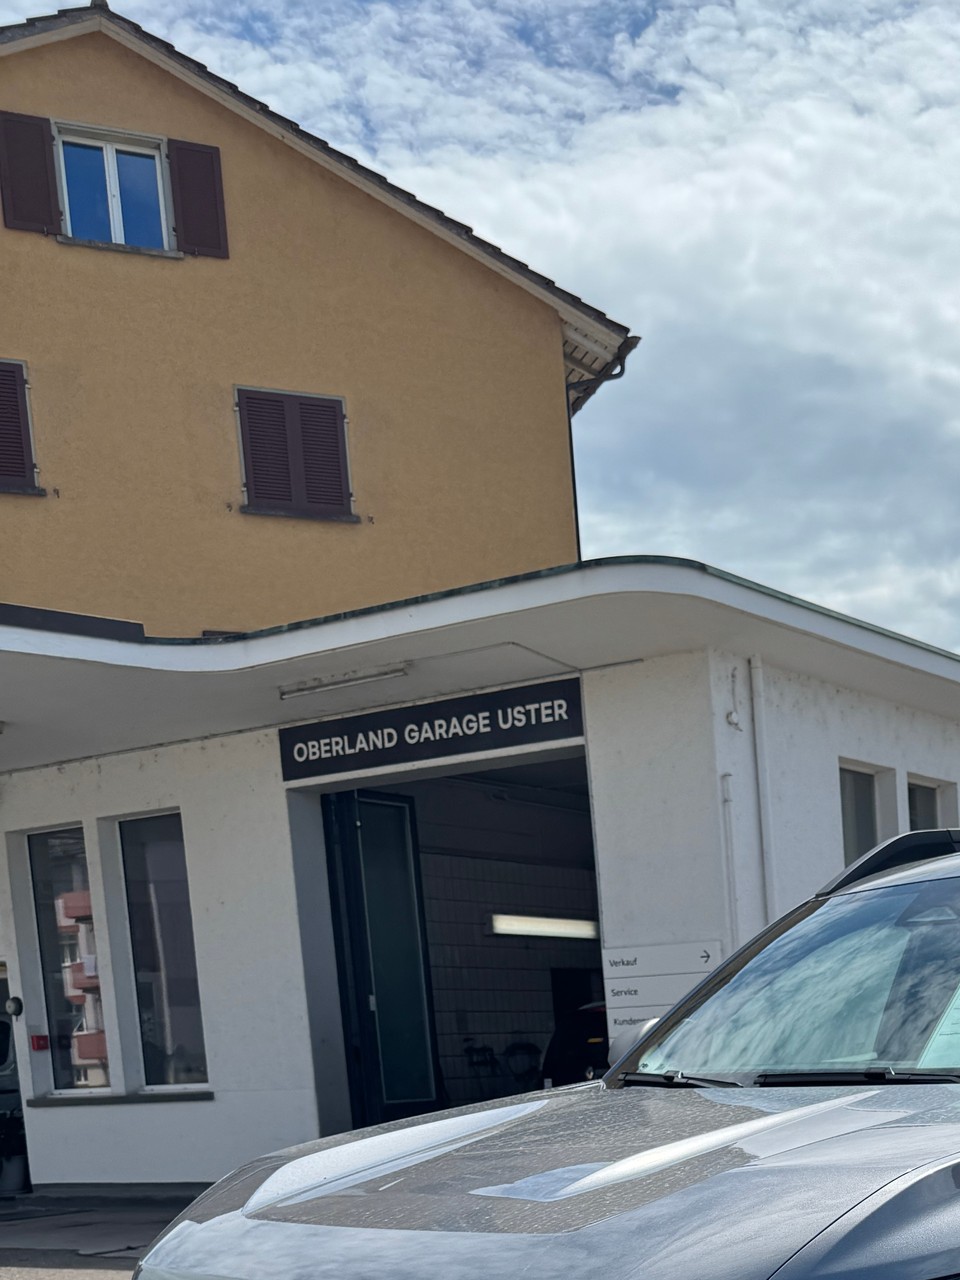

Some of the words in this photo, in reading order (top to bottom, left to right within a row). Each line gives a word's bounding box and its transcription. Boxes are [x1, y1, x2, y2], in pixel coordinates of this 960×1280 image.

[293, 728, 398, 762] OBERLAND
[404, 712, 491, 745] GARAGE
[497, 699, 569, 729] USTER
[608, 957, 638, 967] Verkauf
[611, 988, 639, 997] Service
